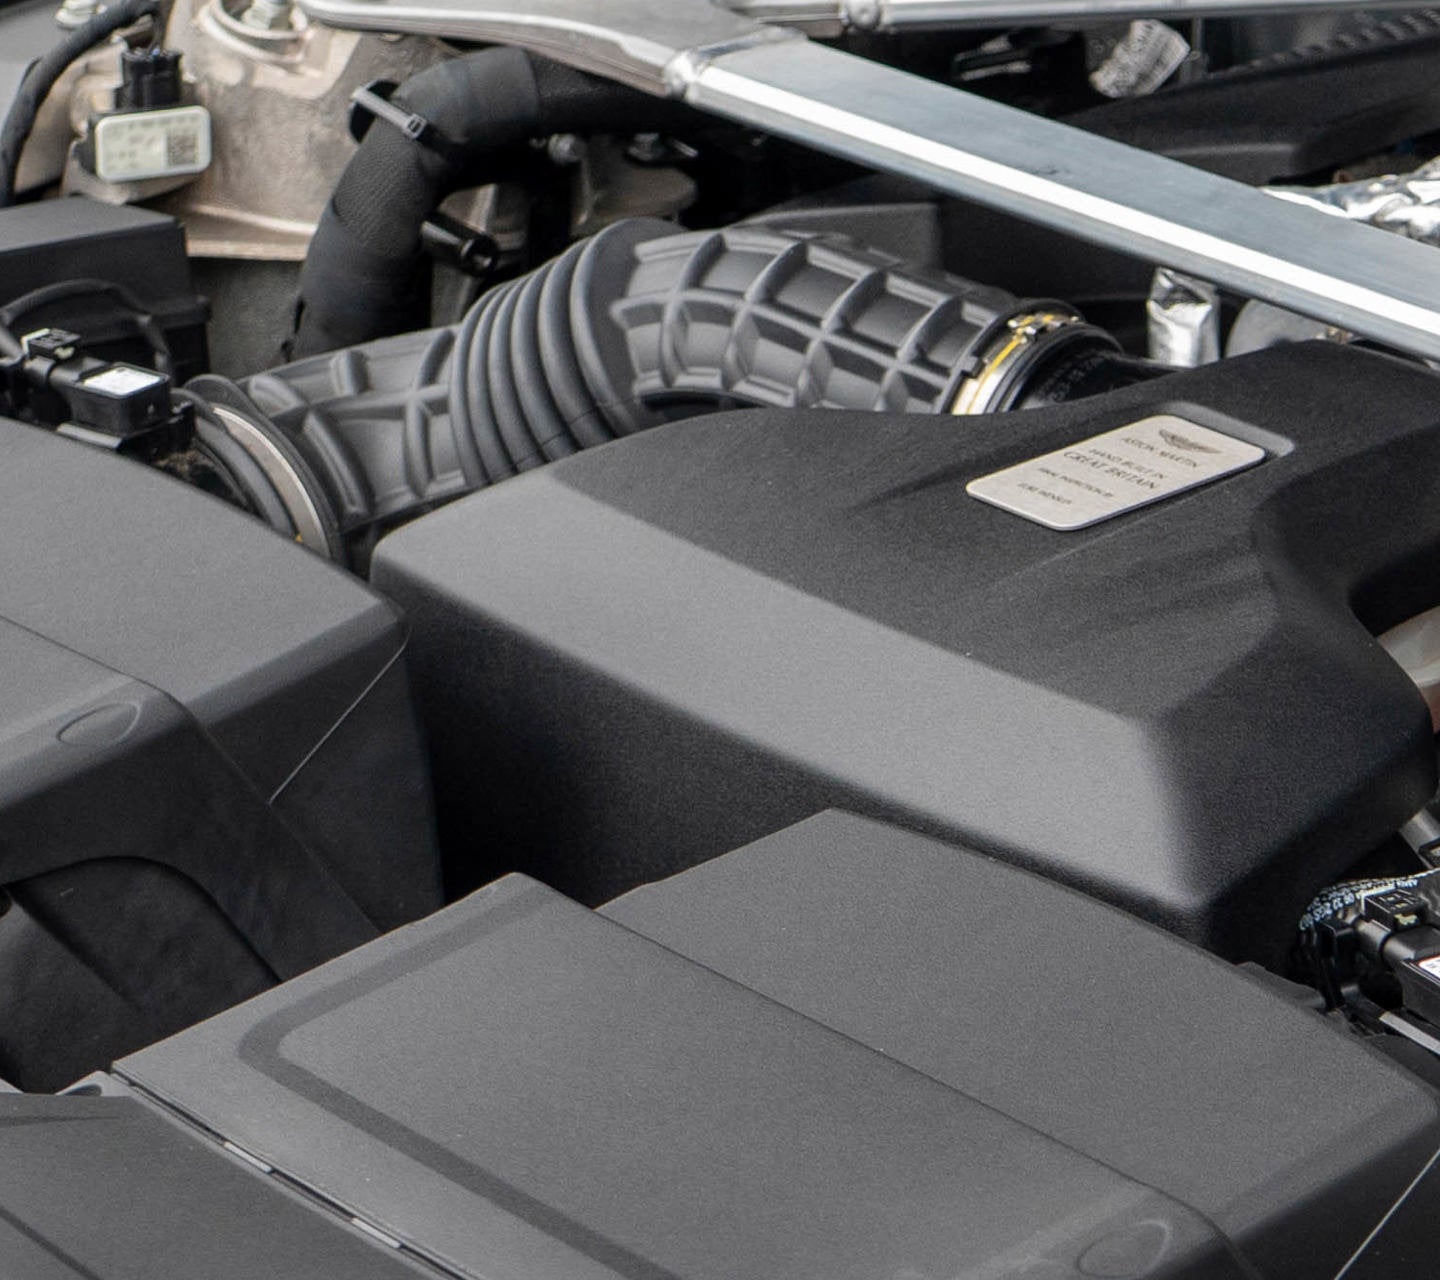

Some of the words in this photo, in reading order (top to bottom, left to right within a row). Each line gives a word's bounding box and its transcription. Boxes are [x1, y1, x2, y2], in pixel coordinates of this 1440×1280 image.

[1088, 449, 1122, 462] HAND
[1122, 437, 1157, 452] ASTON
[1158, 451, 1199, 468] MARTIN
[1063, 450, 1109, 469] GREAT
[1103, 466, 1161, 490] BRITAIN
